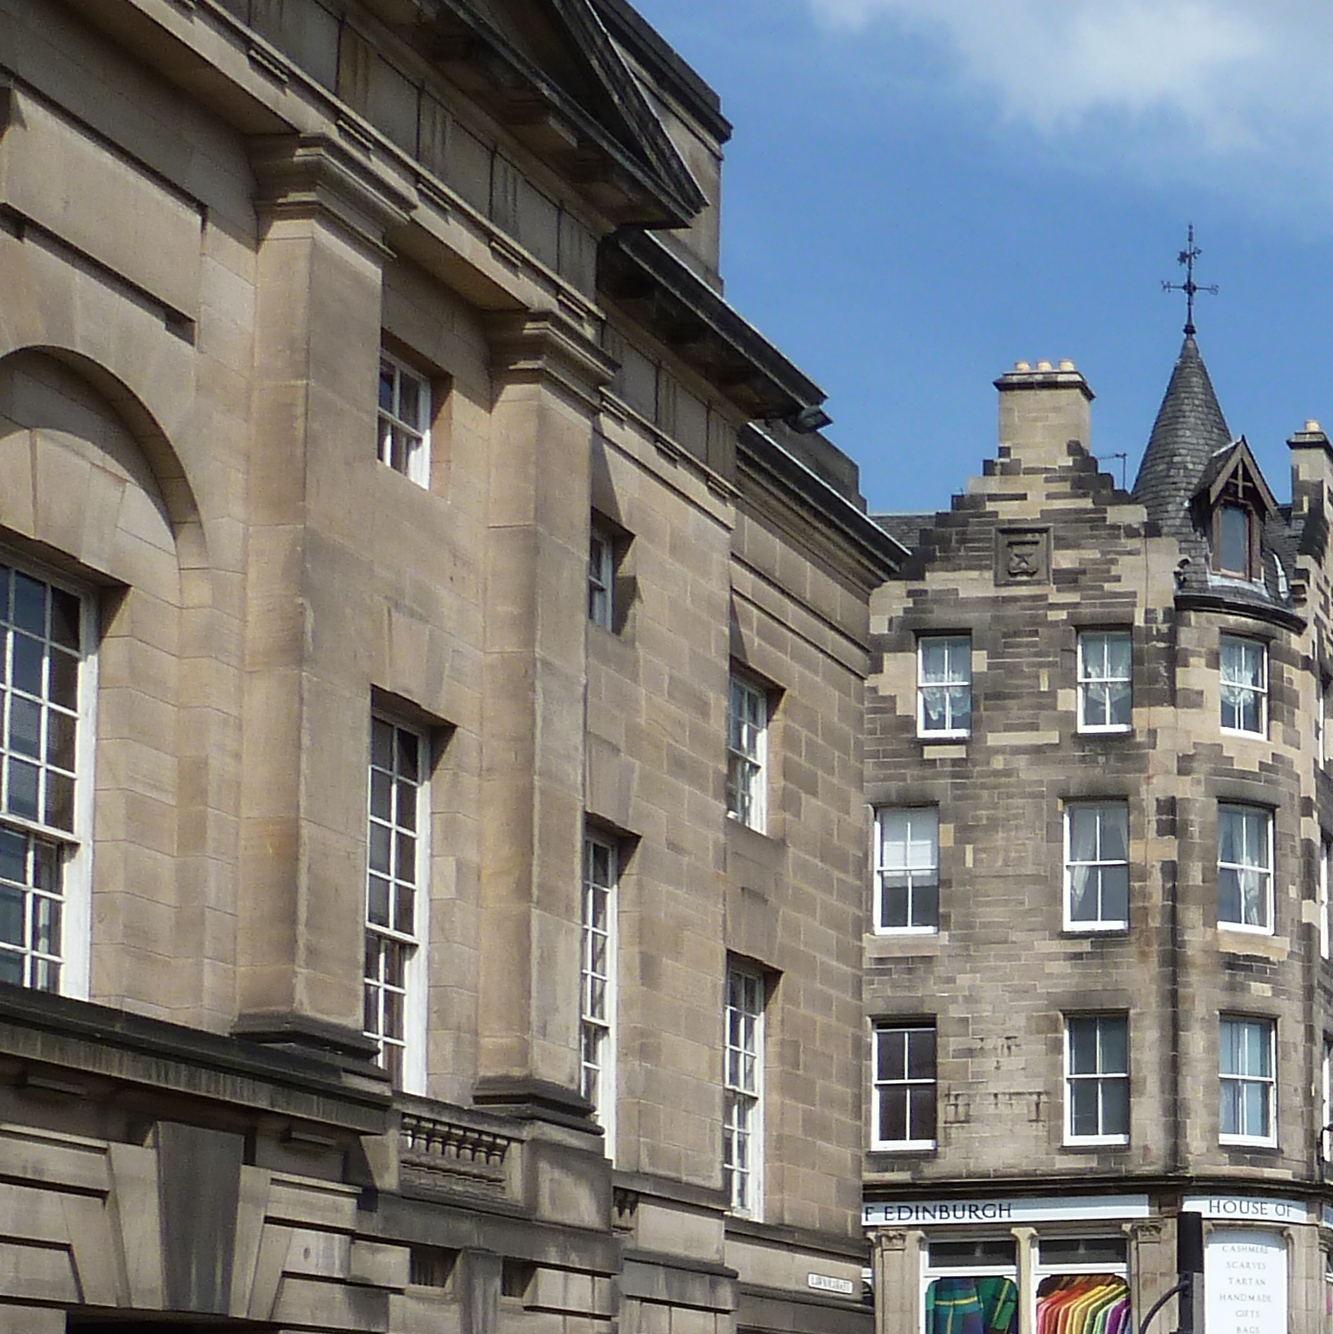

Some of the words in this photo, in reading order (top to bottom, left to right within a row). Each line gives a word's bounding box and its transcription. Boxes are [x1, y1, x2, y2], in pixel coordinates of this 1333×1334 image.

[884, 1203, 1012, 1221] EDINBURGH
[1209, 1200, 1268, 1215] HOUSE
[1275, 1203, 1293, 1217] OF
[1222, 1245, 1268, 1254] CASHMERE
[1226, 1261, 1266, 1270] SCARVES
[1228, 1277, 1266, 1286] TARTAN
[1219, 1293, 1272, 1302] HANDMADE
[1235, 1309, 1260, 1318] GIFTS
[1236, 1326, 1260, 1334] BAGS
